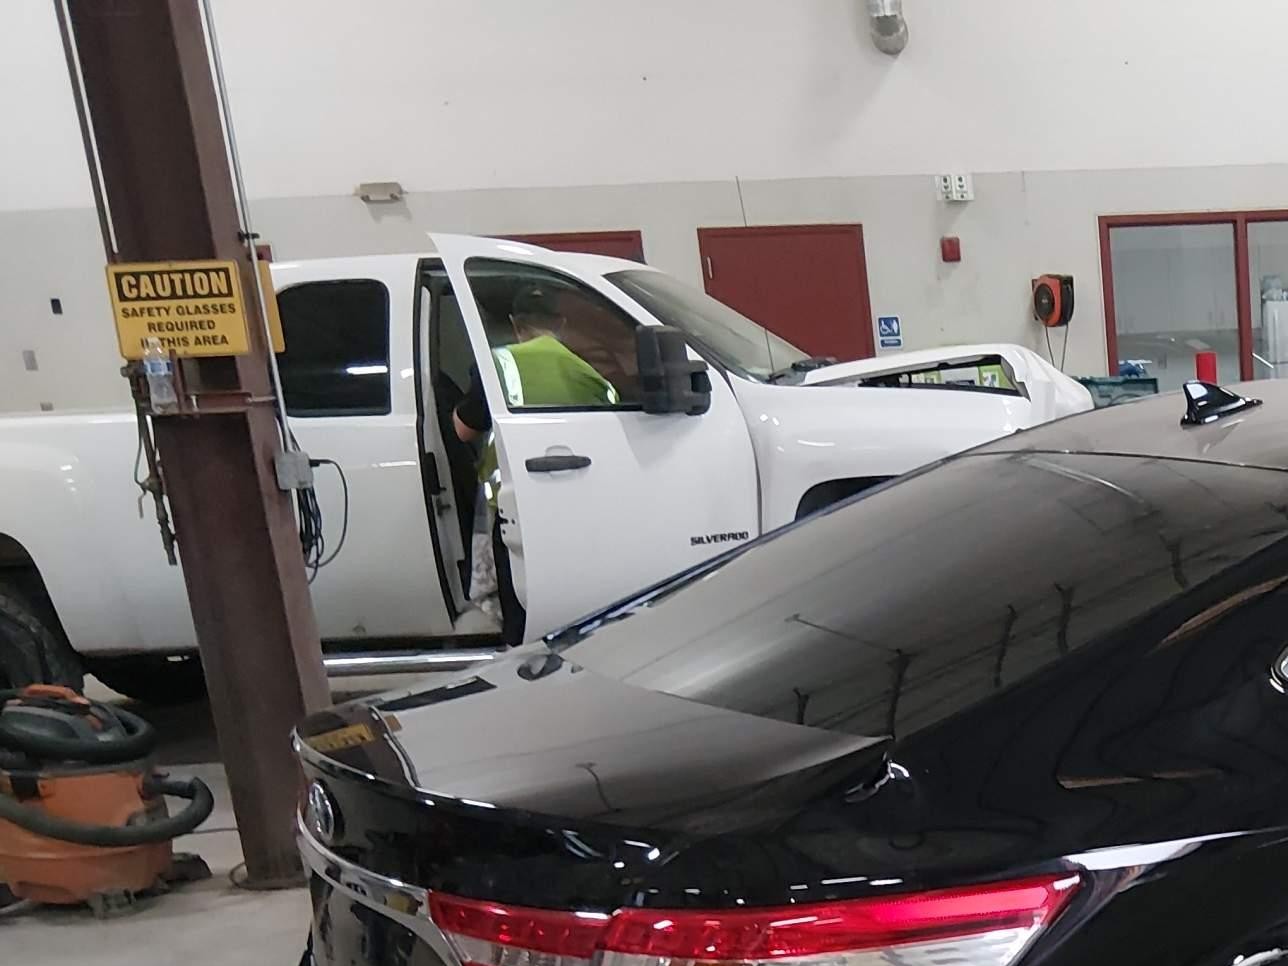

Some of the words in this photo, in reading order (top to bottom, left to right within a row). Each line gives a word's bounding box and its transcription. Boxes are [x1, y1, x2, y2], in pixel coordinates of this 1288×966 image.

[121, 271, 229, 299] CAUTION
[121, 305, 171, 318] SAFETY
[175, 303, 236, 316] GLASSES
[147, 320, 216, 333] REQUIRED
[158, 336, 190, 348] THIS
[194, 334, 229, 346] AREA
[690, 531, 749, 546] SILVERADO
